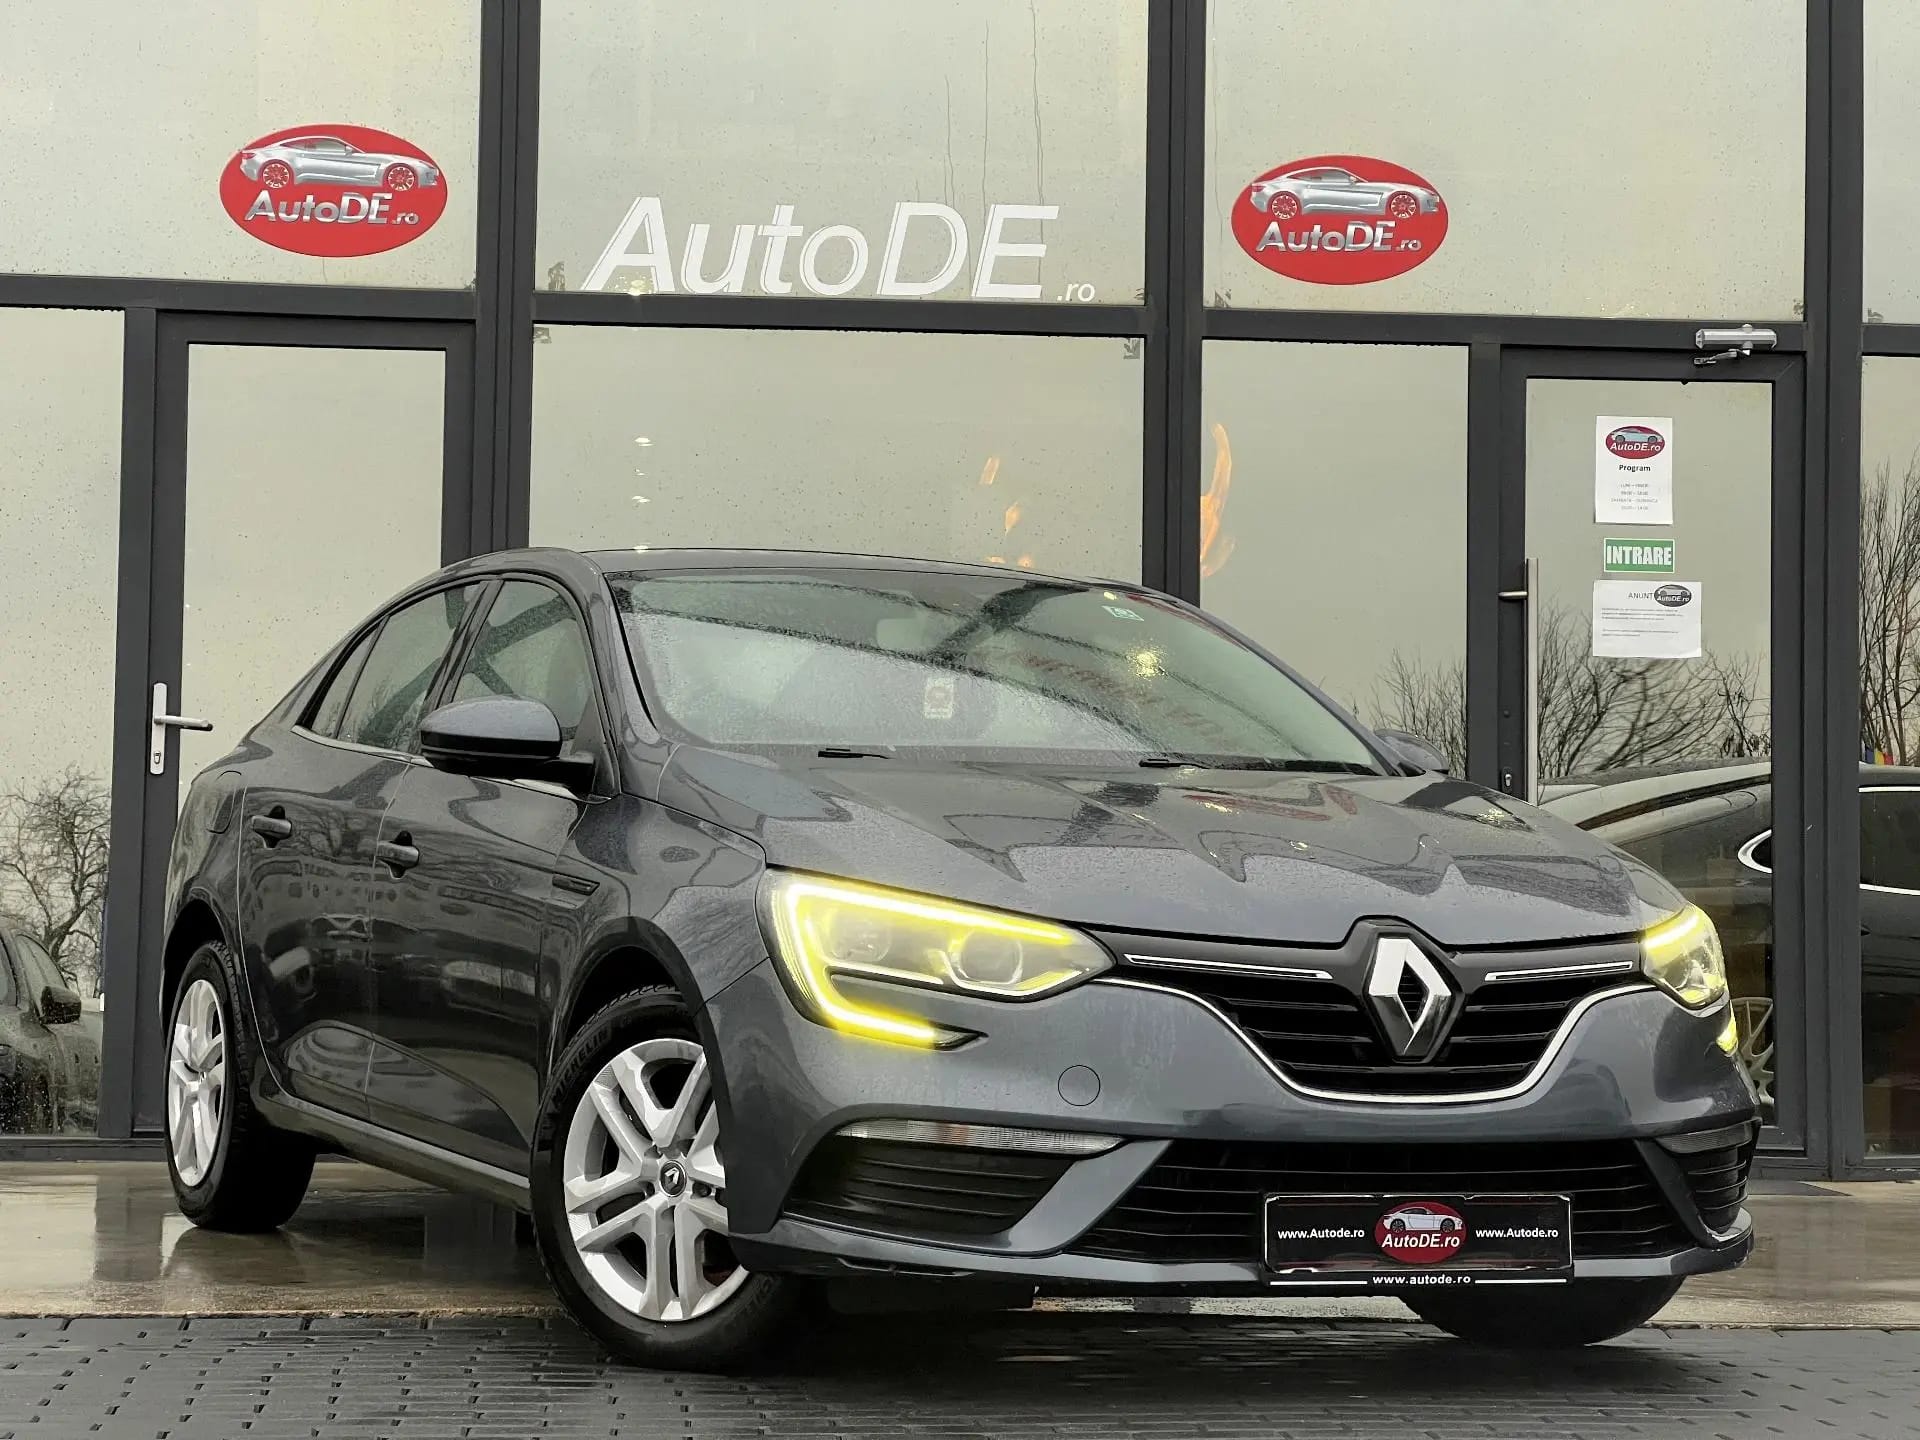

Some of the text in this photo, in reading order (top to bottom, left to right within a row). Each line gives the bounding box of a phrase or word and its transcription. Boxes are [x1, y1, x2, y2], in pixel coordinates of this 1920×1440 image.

[1609, 442, 1661, 452] AutoDE.ro
[1618, 464, 1651, 472] Program
[1606, 545, 1672, 566] INTRARE
[1277, 1228, 1365, 1239] www.Autode.ro
[1475, 1227, 1559, 1239] www.Autode.ro
[1381, 1233, 1460, 1249] AutoDE.ro
[1372, 1273, 1471, 1285] www.autode.ro
